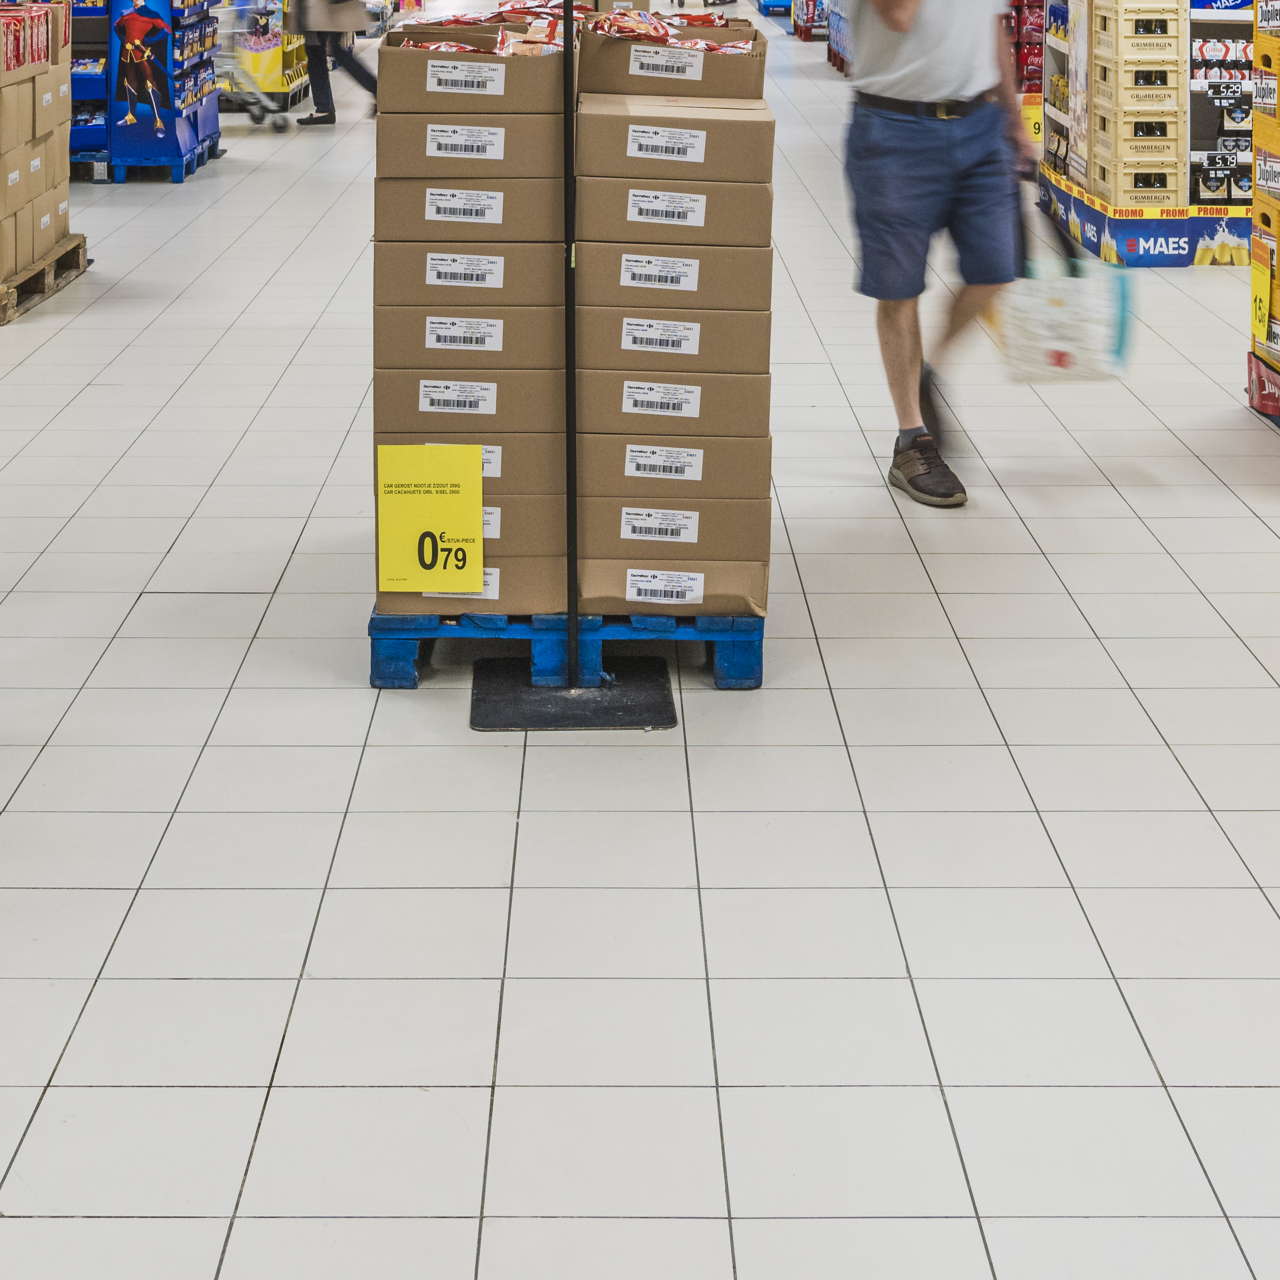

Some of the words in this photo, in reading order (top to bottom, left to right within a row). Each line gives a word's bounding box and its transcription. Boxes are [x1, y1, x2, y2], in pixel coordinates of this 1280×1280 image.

[1131, 41, 1172, 49] GRIMBERGEN
[1131, 93, 1172, 101] GRIMBERGEN
[1129, 144, 1171, 152] GRIMBERGEN
[1129, 194, 1171, 202] GRIMBERGEN
[1113, 209, 1144, 219] PROMO
[1197, 207, 1229, 217] PROMO
[1139, 237, 1189, 255] MAES
